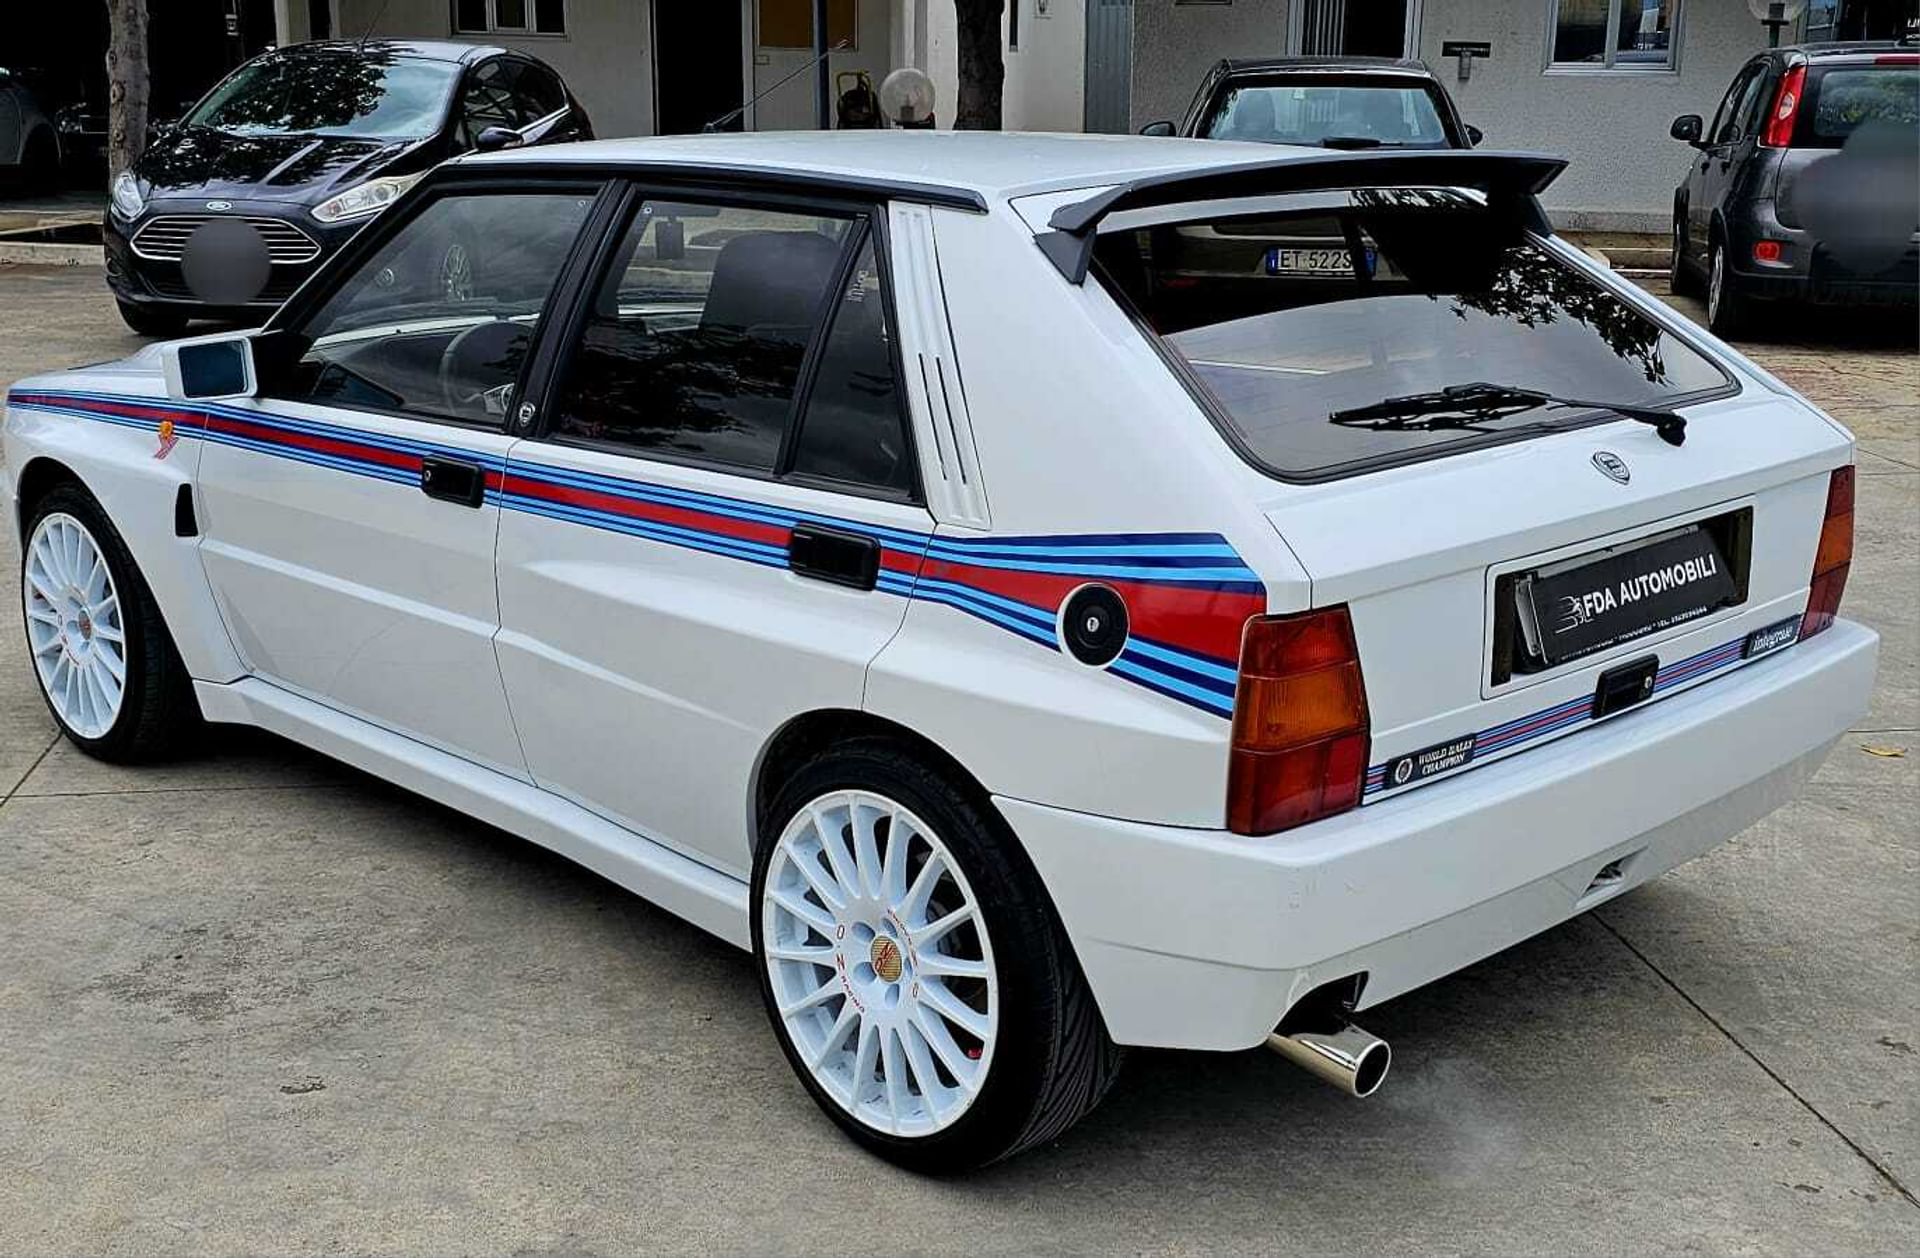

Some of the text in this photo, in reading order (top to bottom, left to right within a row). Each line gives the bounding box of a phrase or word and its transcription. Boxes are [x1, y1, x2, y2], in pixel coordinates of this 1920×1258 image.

[1281, 251, 1304, 267] ET
[1309, 252, 1352, 268] 522S
[1582, 554, 1717, 617] FDA AUTOMOBILI
[1419, 748, 1446, 765] WORLD
[1422, 753, 1465, 775] CHAMPION
